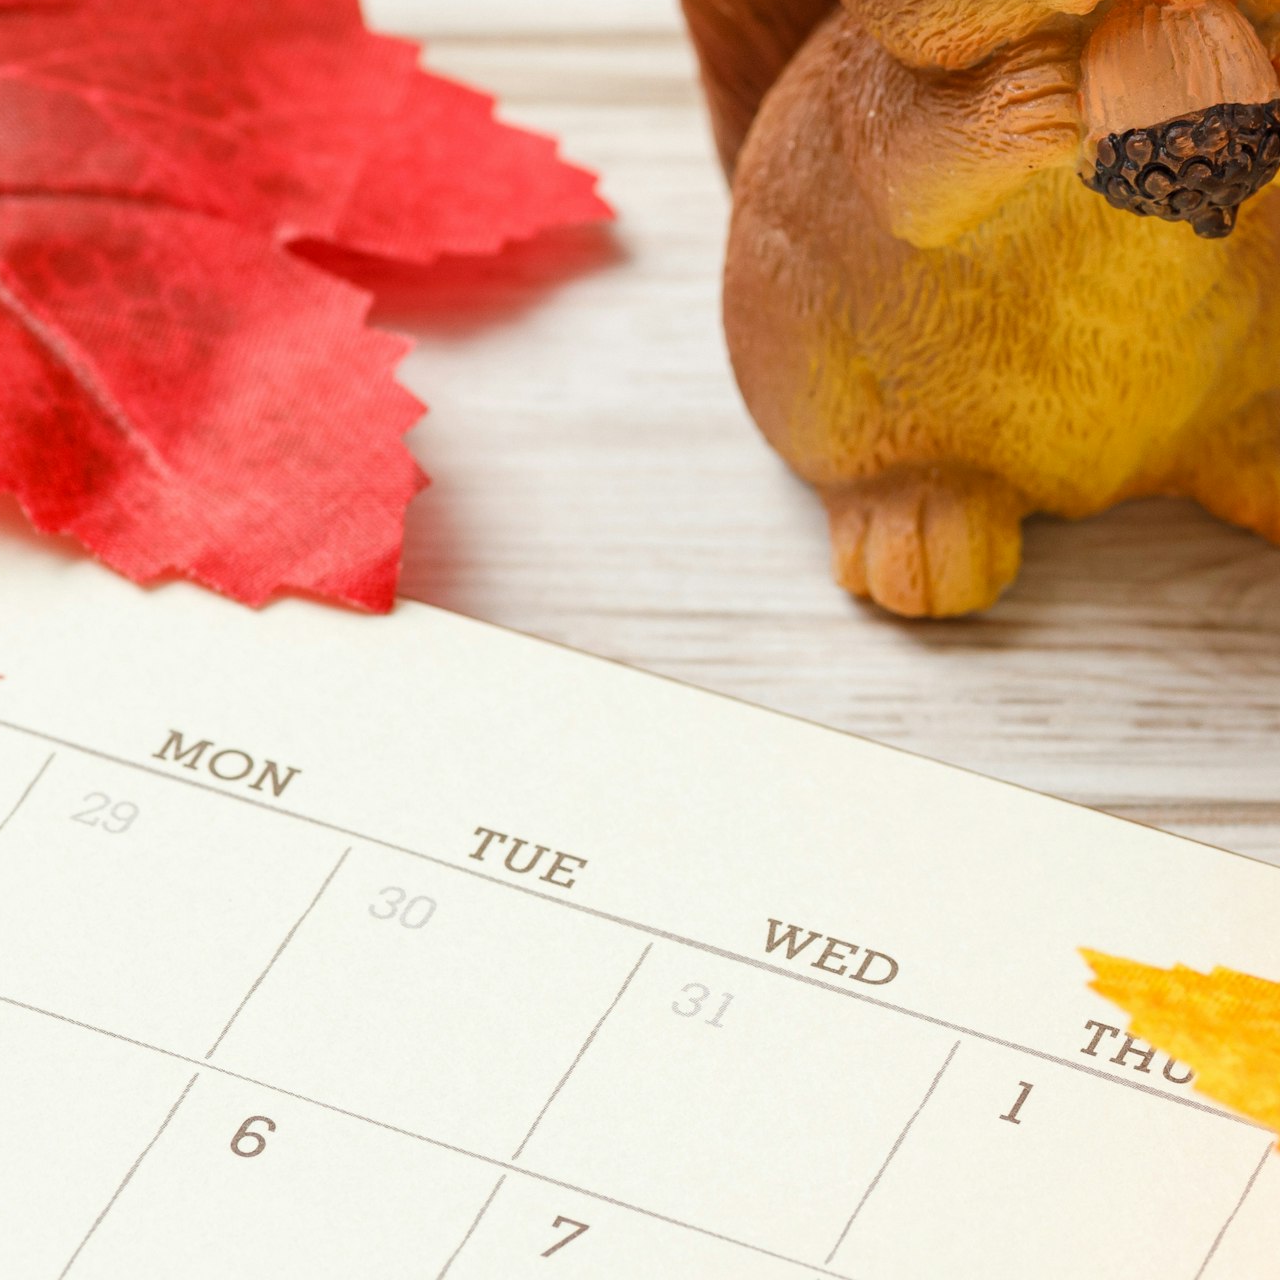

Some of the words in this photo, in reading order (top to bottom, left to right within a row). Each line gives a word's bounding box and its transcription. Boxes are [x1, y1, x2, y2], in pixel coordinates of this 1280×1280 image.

[69, 790, 141, 835] 29
[367, 885, 438, 930] 30
[671, 982, 735, 1029] 31
[997, 1079, 1035, 1126] 1
[150, 727, 304, 799] MON
[467, 824, 590, 891] TUE
[763, 916, 900, 987] WED
[229, 1114, 278, 1159] 6
[539, 1214, 592, 1259] 7
